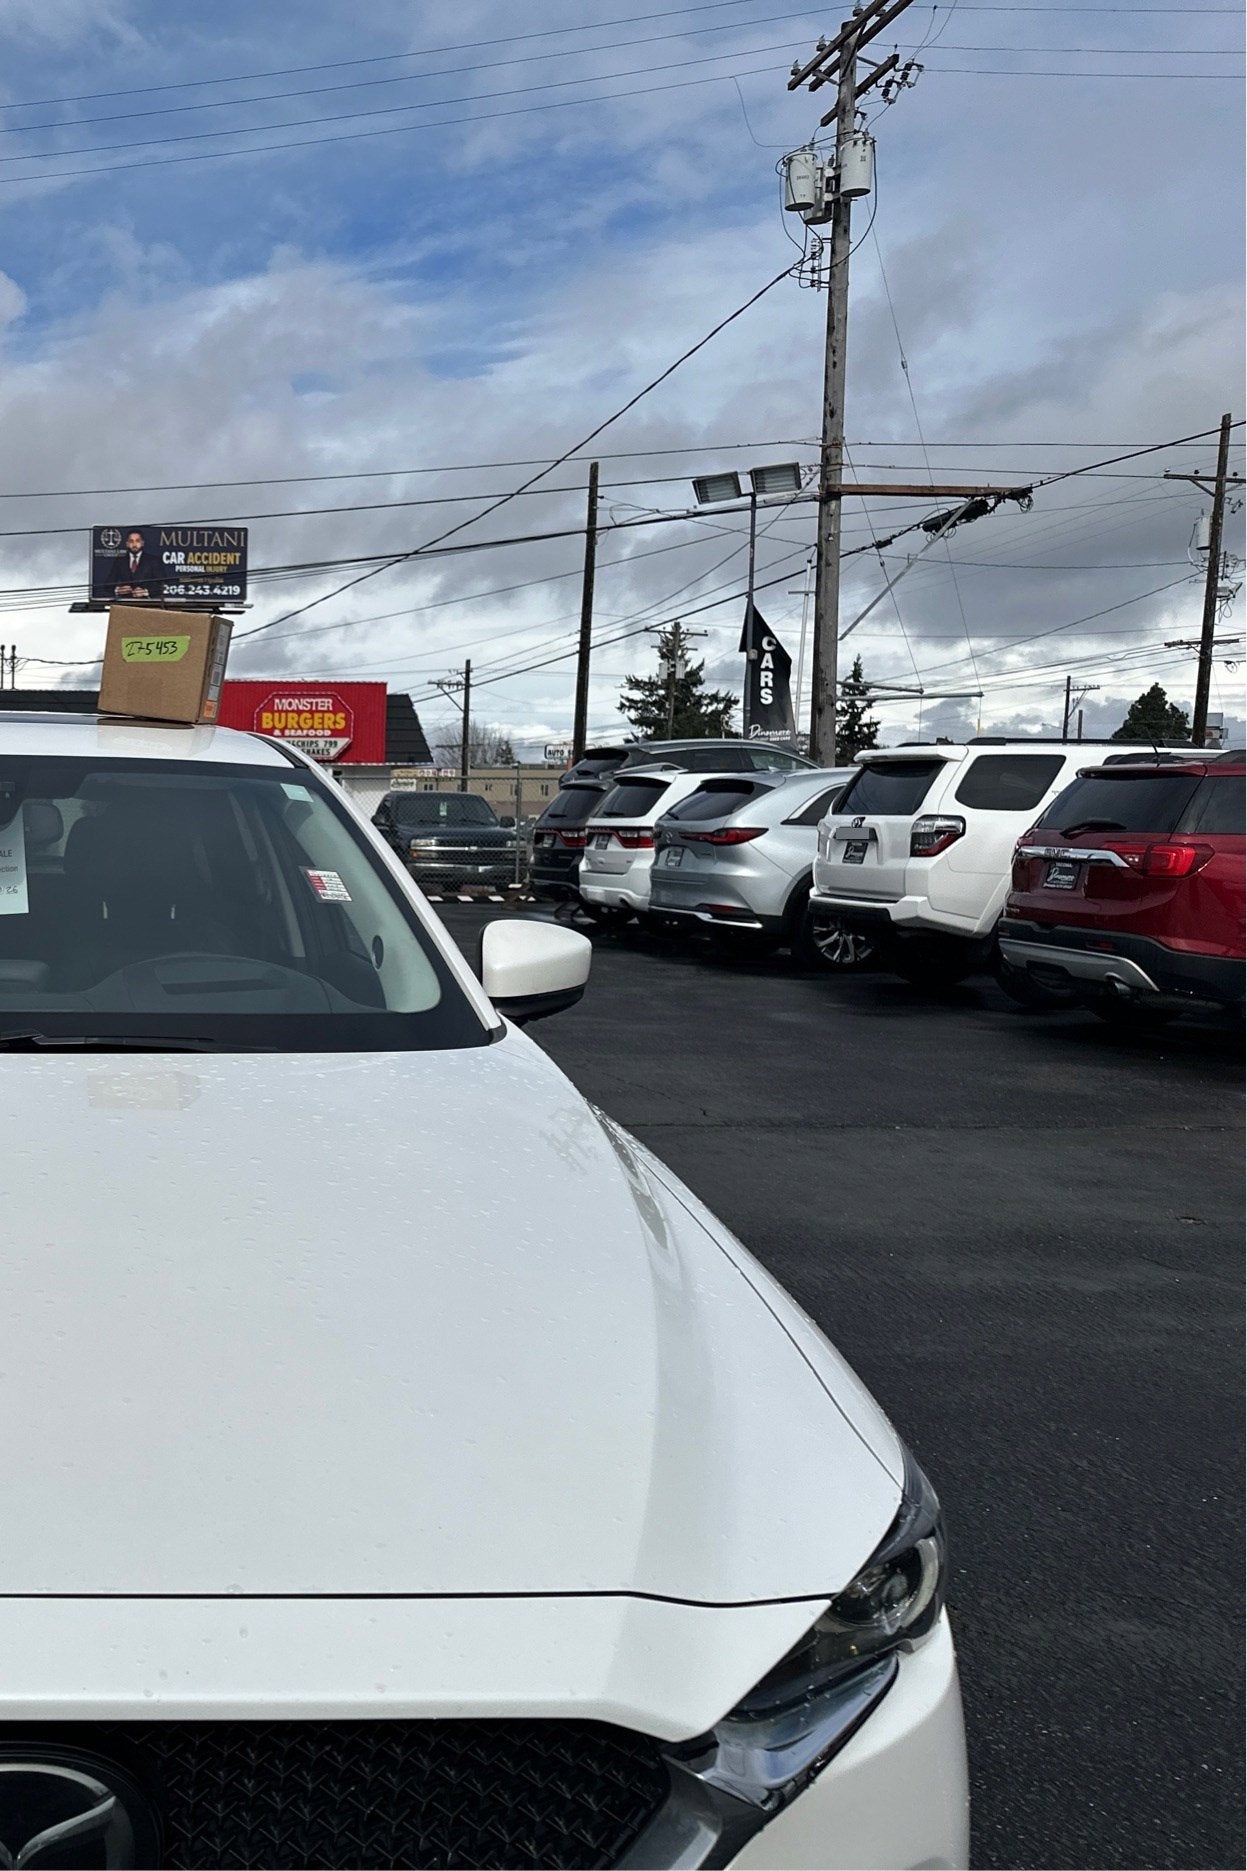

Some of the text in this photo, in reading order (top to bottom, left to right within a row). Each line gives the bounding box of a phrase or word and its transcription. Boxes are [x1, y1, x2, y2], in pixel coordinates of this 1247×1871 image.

[159, 530, 245, 547] MULTANI
[162, 551, 241, 565] CAR ACCIDENT
[175, 565, 205, 573] PERSONAL
[163, 584, 241, 595] 206.243.4219
[125, 640, 178, 657] 275453
[760, 636, 776, 704] CARS
[274, 698, 333, 711] MONSTER
[261, 712, 346, 729] BURGERS
